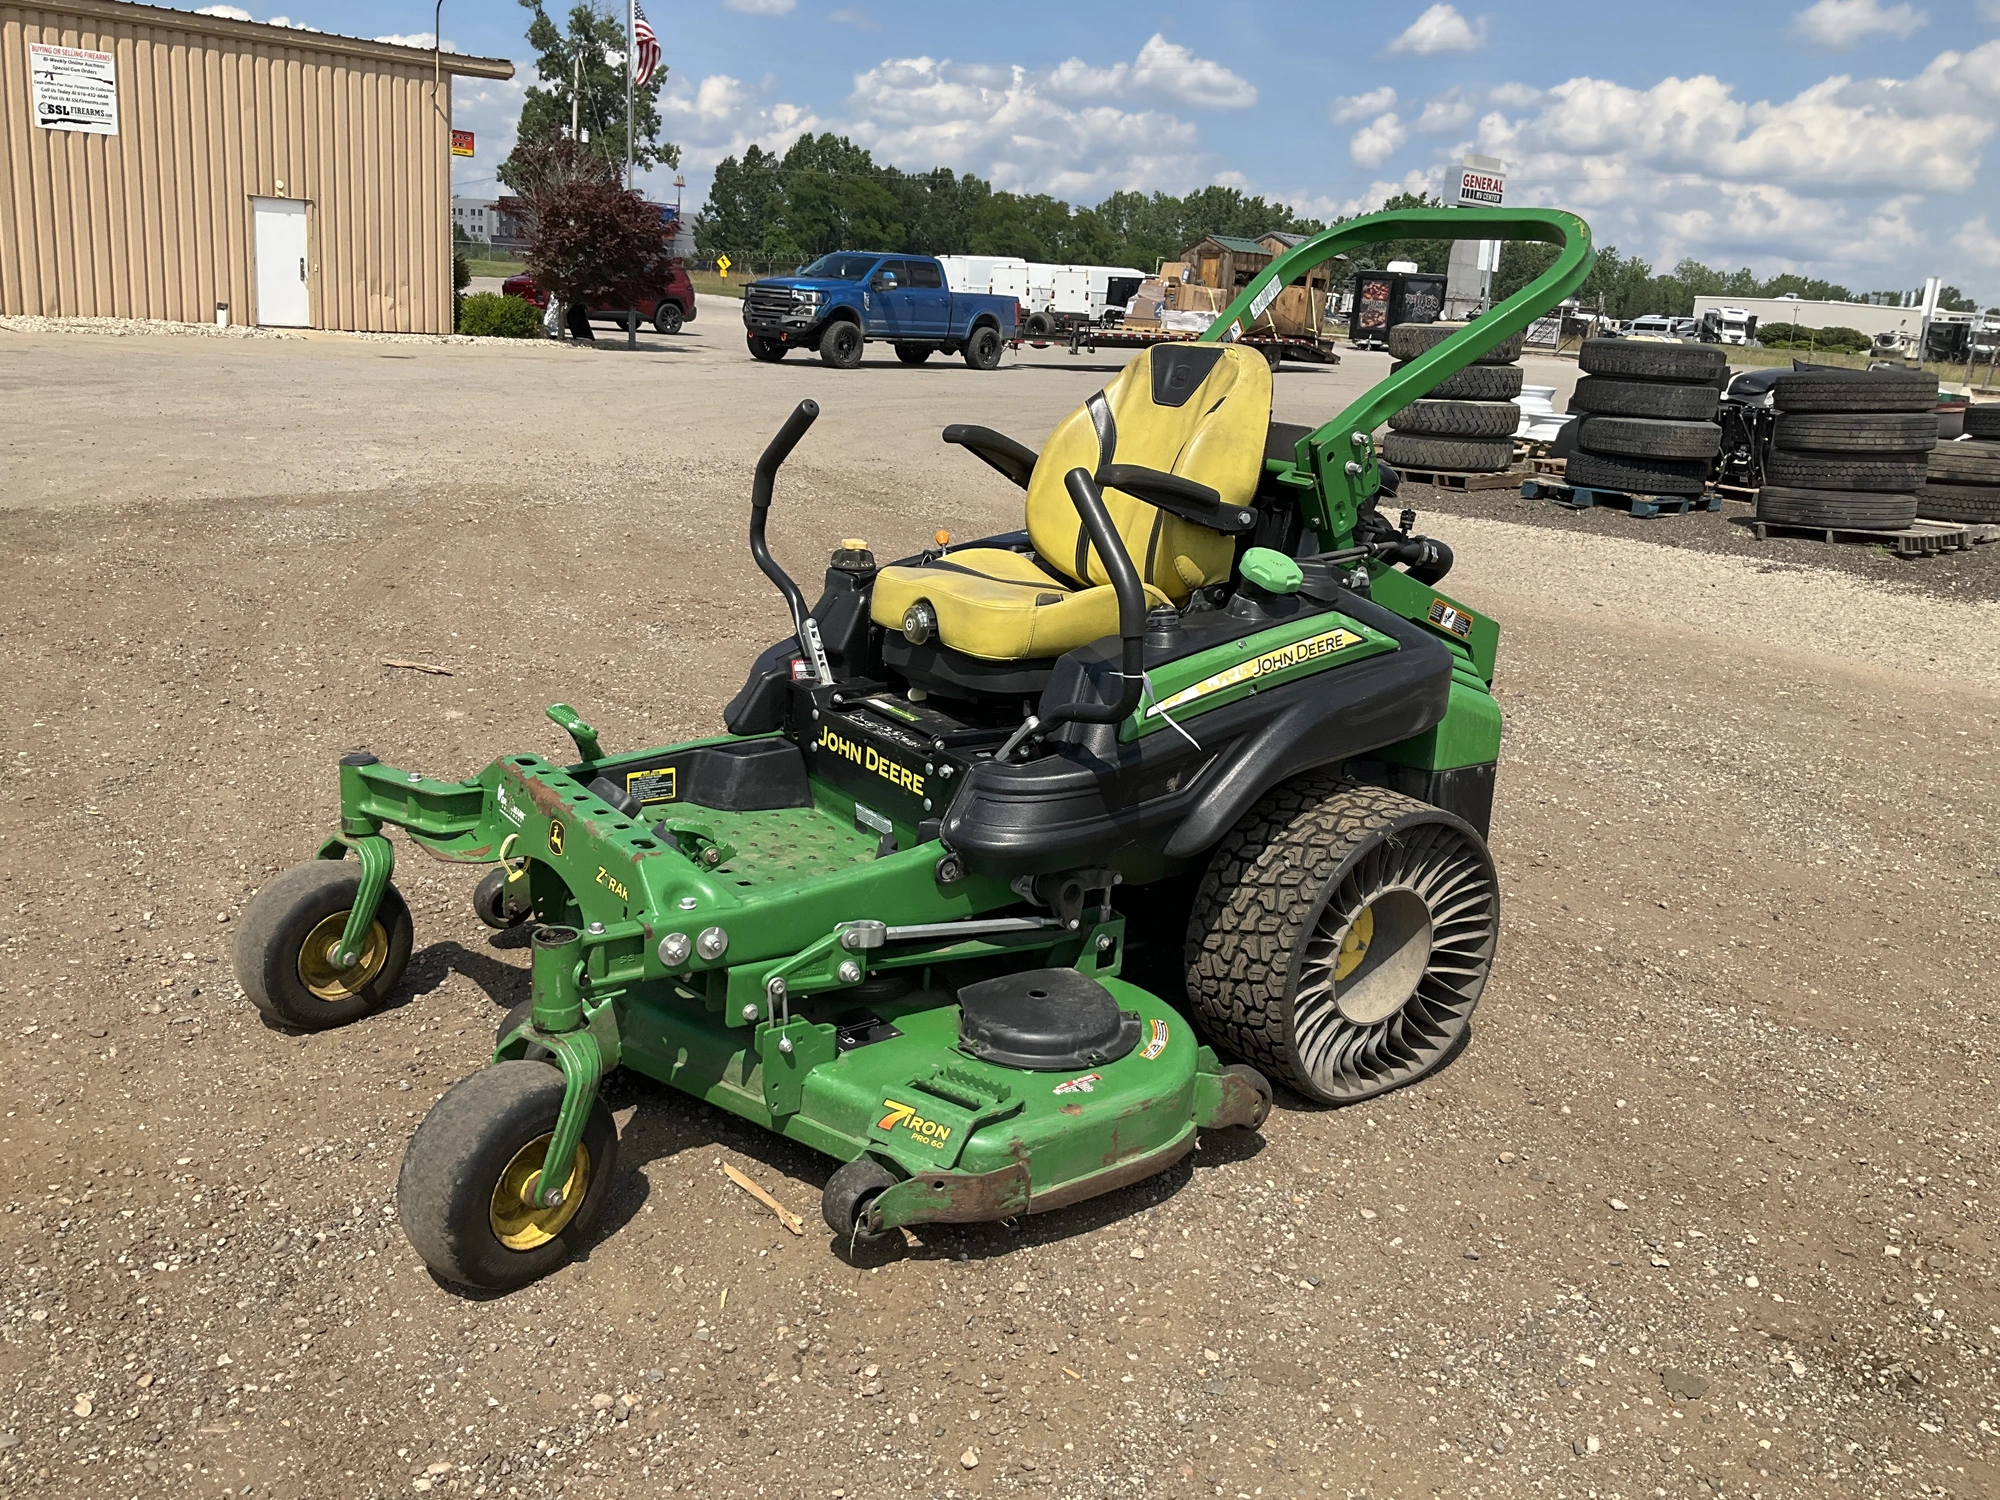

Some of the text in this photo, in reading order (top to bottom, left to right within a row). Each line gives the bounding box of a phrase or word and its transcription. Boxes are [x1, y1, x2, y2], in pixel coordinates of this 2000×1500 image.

[32, 45, 52, 54] BUYING
[53, 47, 61, 55] OR
[62, 48, 83, 58] SELLING
[48, 104, 70, 115] SSL
[70, 106, 105, 117] FIREARMS
[1463, 173, 1503, 193] GENERAL
[1475, 191, 1500, 203] RV CENTER
[1253, 634, 1343, 676] JOHN DEERE
[818, 725, 862, 765] JOHN
[865, 746, 925, 796] DEERE
[595, 865, 629, 902] ZRAK
[910, 1132, 944, 1149] PRO 60
